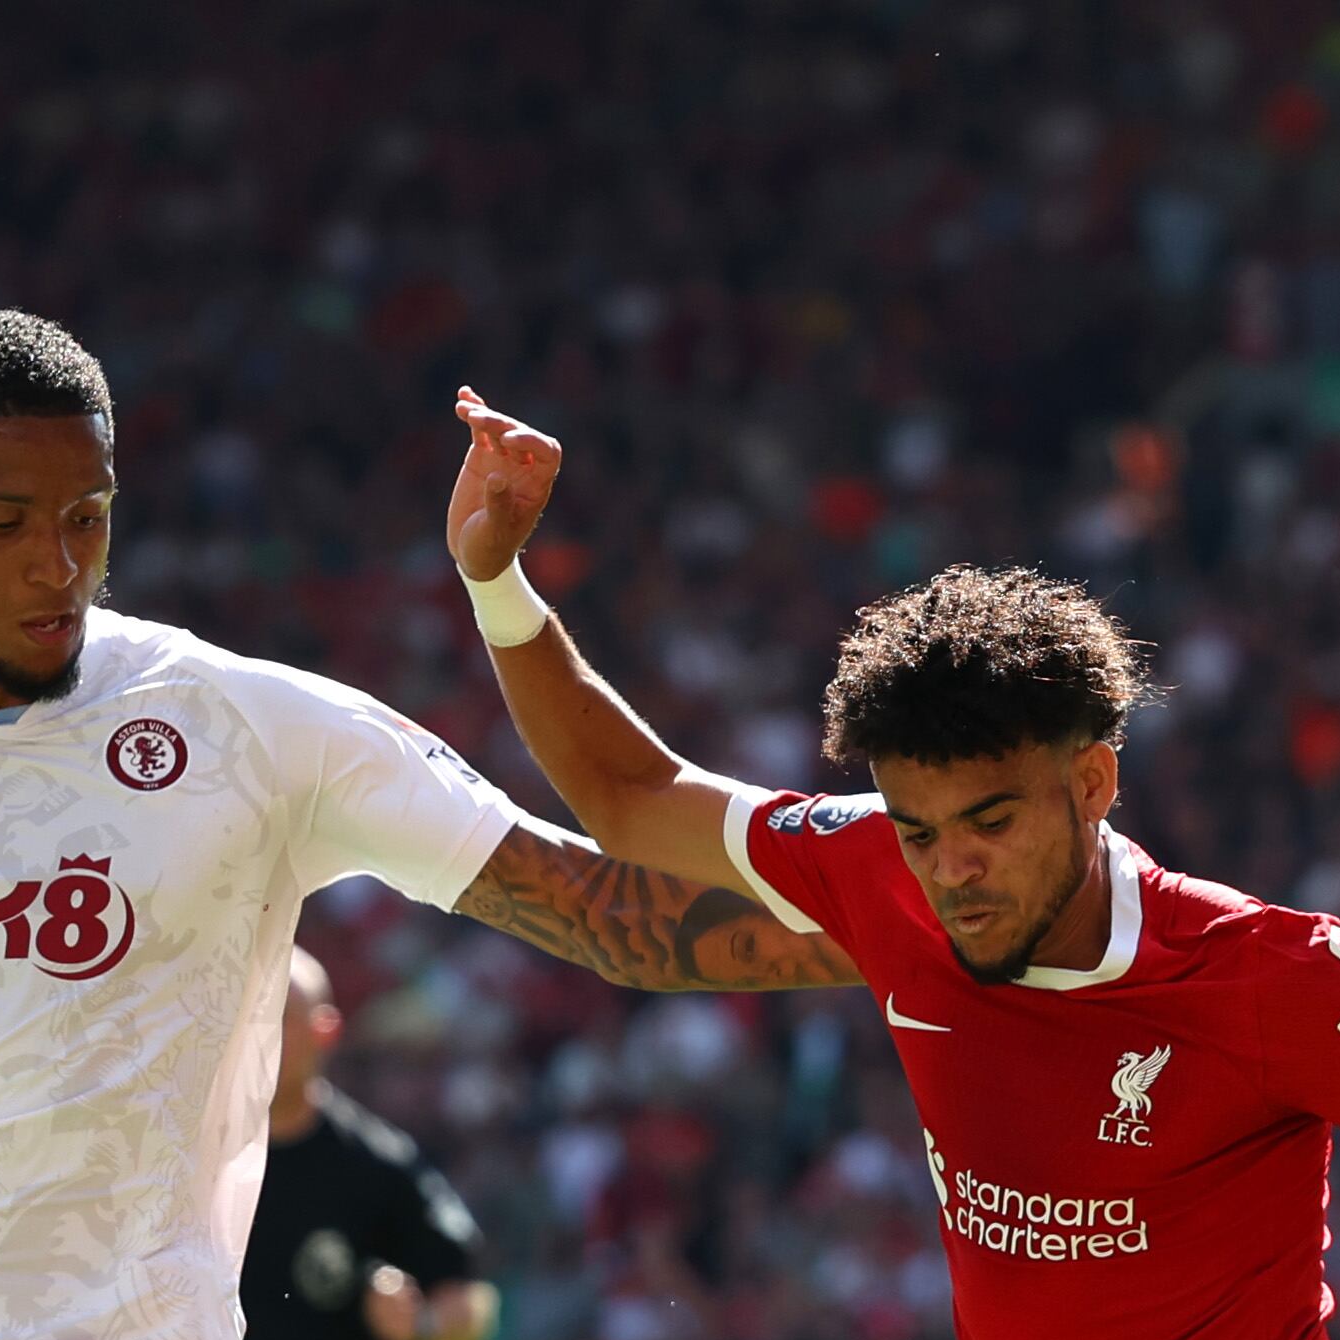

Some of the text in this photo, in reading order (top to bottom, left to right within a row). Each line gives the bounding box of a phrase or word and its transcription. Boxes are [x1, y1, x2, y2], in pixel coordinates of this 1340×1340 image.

[114, 722, 178, 746] ASTON VILLA
[956, 1169, 1134, 1226] standard
[957, 1206, 1148, 1261] chartered
